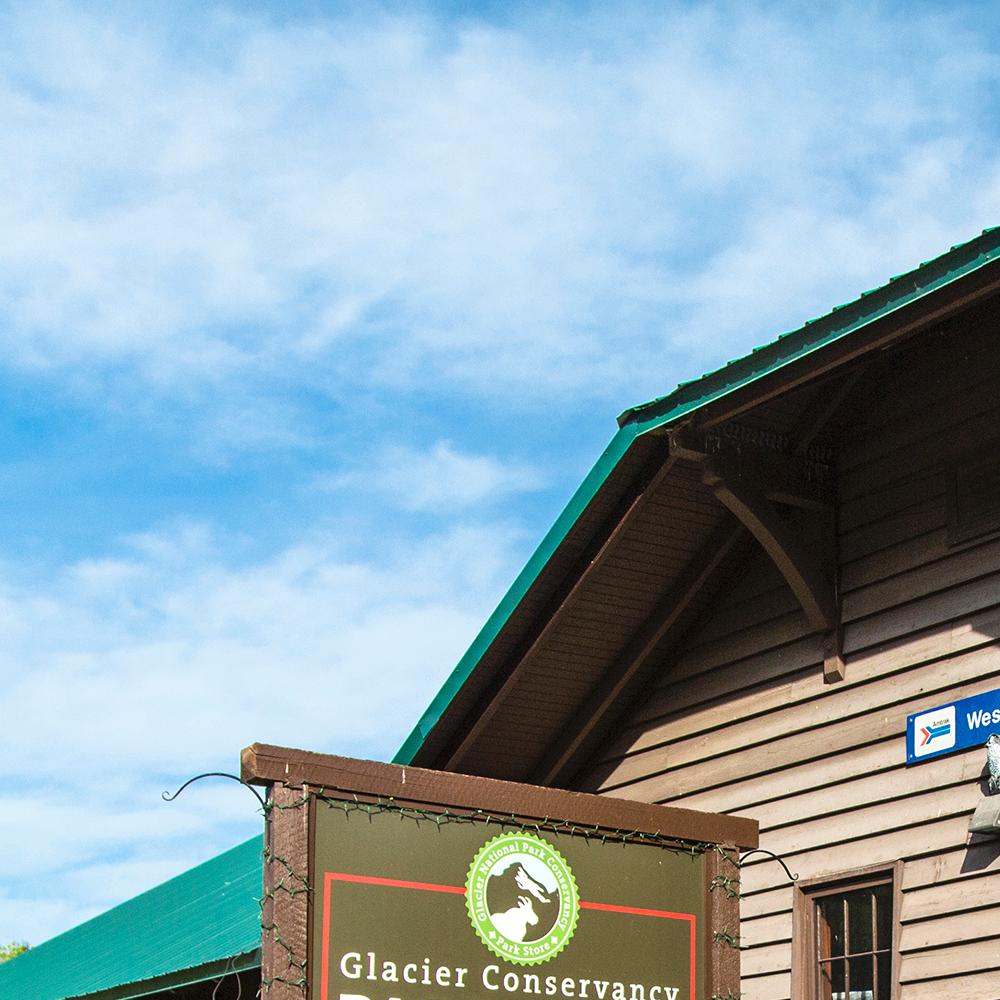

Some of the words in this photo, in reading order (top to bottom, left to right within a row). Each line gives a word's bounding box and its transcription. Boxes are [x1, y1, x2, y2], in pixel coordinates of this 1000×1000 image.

[479, 842, 519, 875] National
[522, 842, 546, 859] Park
[474, 875, 487, 922] Glacier
[547, 858, 570, 931] Conservancy
[496, 937, 520, 954] Park
[523, 941, 551, 956] Store
[340, 952, 468, 988] Glacier
